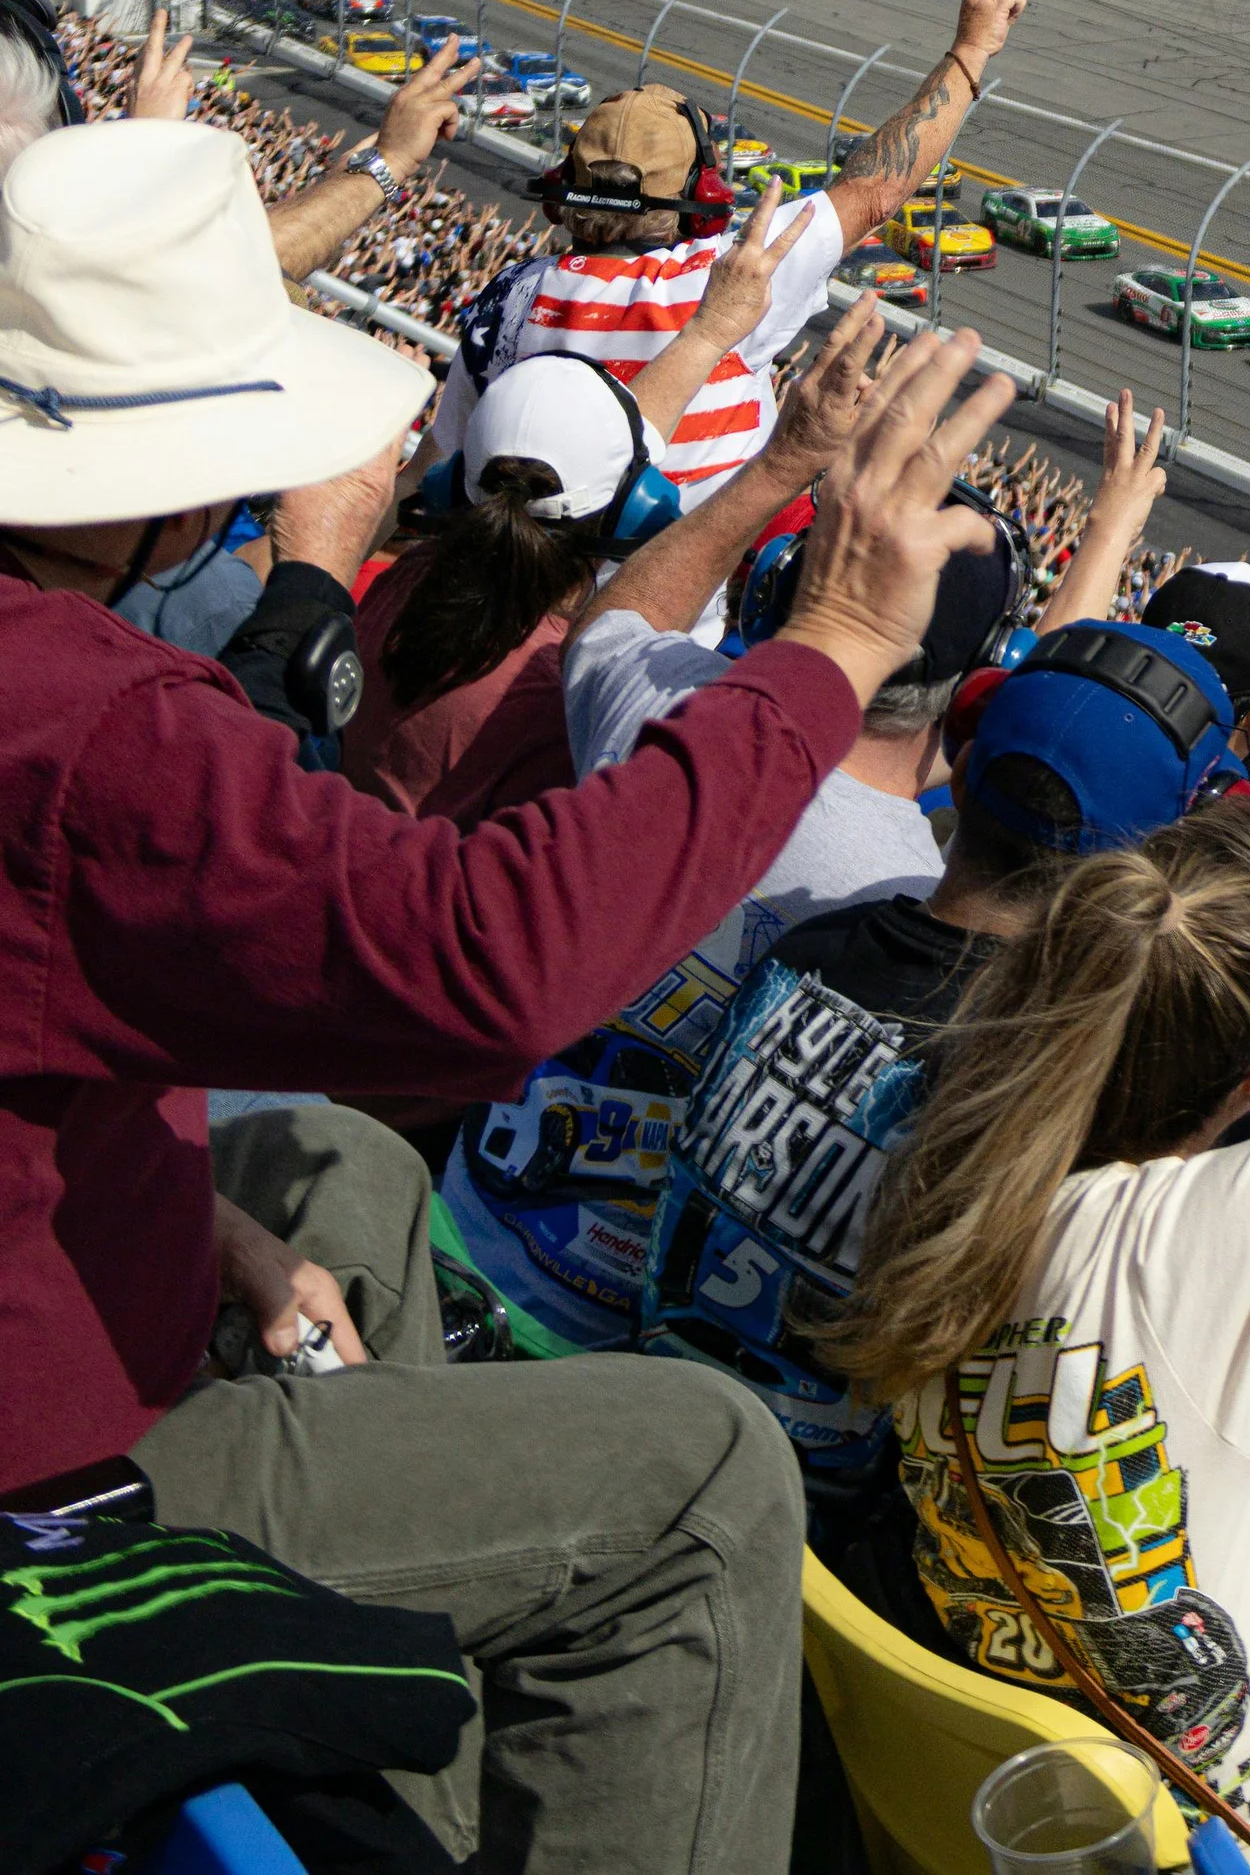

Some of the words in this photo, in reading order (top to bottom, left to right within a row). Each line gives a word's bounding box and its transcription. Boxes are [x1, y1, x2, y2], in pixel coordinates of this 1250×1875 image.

[567, 191, 592, 203] RACING
[747, 988, 901, 1119] KYLE
[585, 1099, 633, 1165] 9
[586, 1223, 649, 1261] Hendric
[700, 1237, 783, 1309] 5
[598, 1288, 632, 1313] GA
[986, 1609, 1054, 1677] 20
